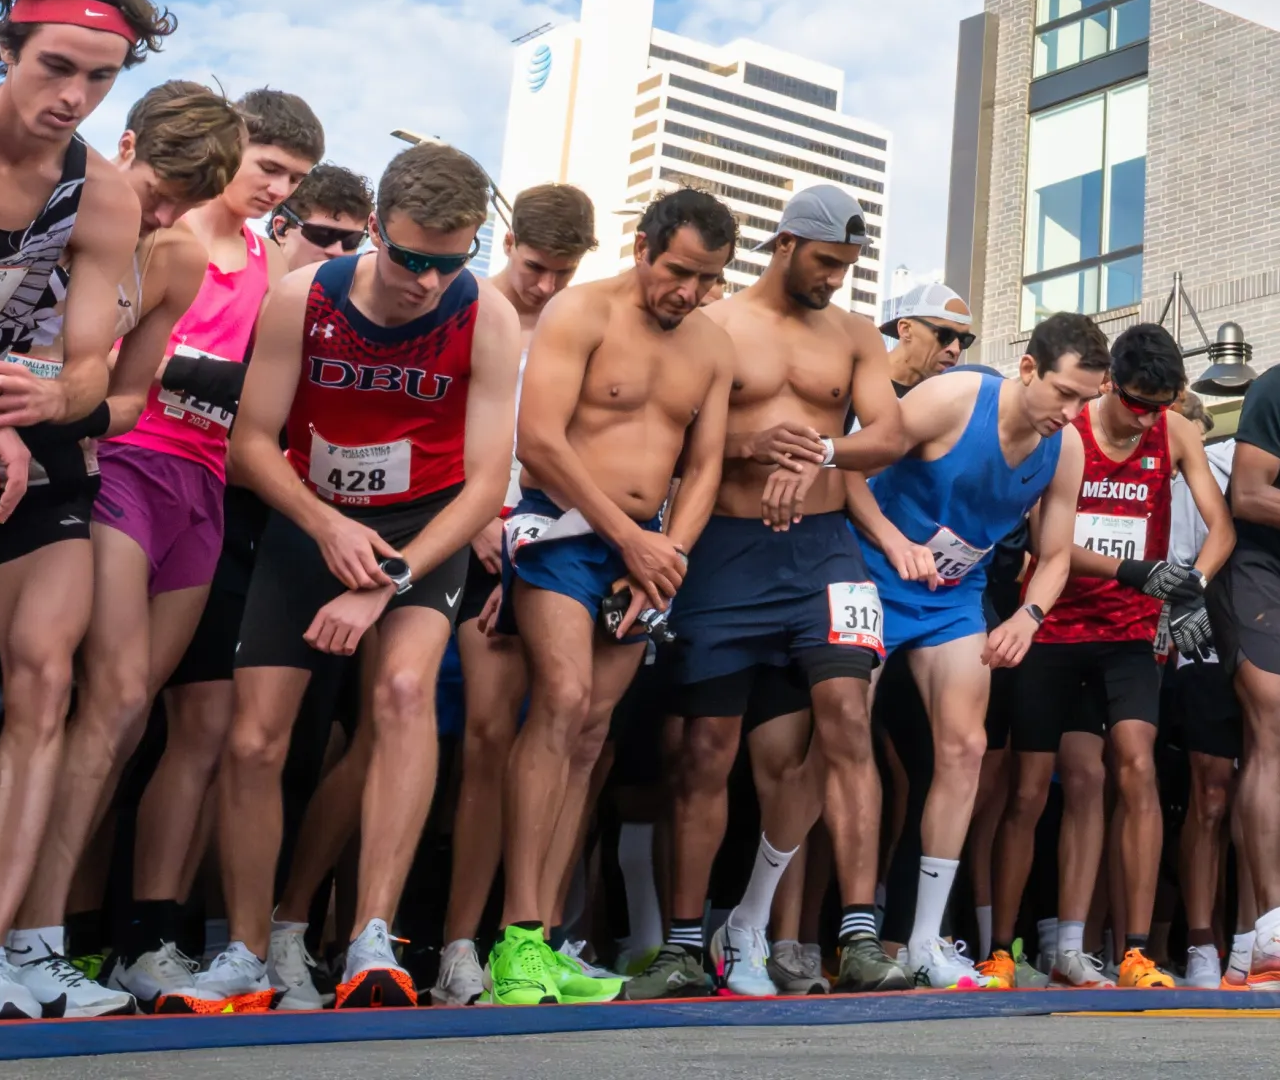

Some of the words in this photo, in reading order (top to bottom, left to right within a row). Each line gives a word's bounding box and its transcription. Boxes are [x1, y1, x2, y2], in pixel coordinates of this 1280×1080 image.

[308, 355, 454, 402] DBU
[327, 468, 387, 492] 428
[1081, 477, 1149, 502] MÉXICO
[339, 495, 371, 505] 2025
